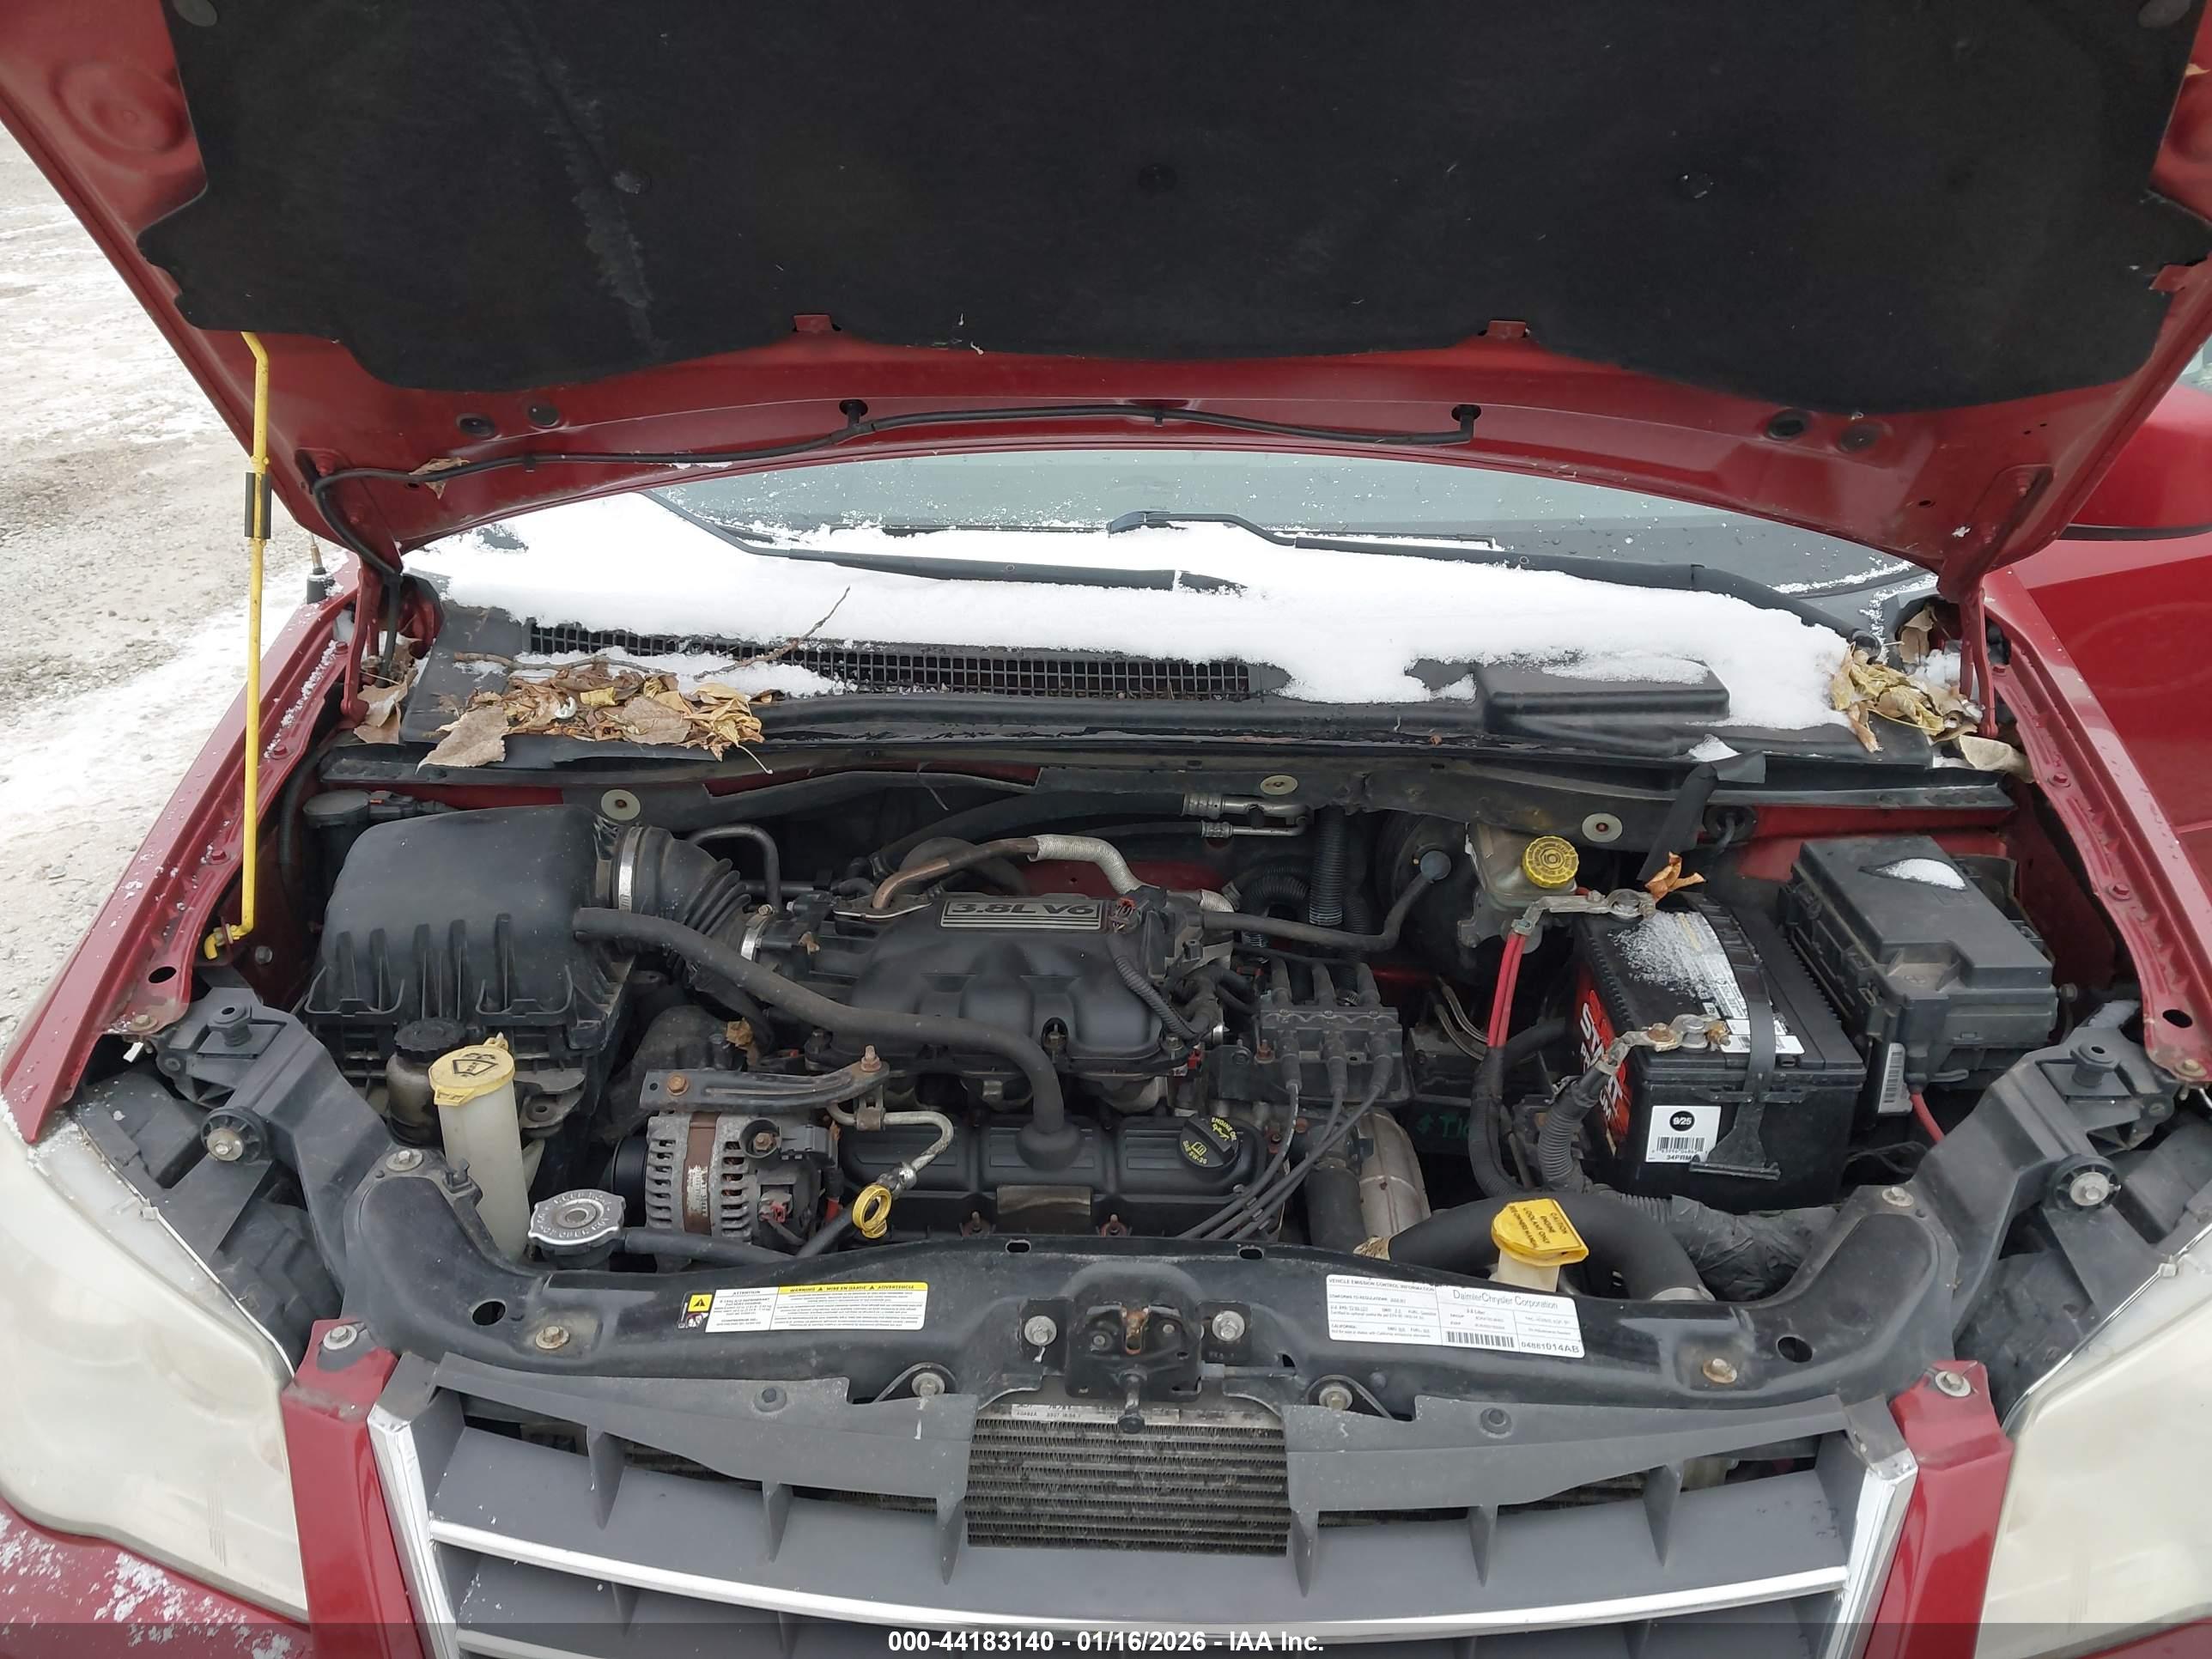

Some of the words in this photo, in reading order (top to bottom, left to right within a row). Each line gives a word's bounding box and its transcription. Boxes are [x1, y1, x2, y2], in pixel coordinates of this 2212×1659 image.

[951, 903, 1036, 914] 3.8L
[1043, 904, 1095, 915] V6
[1211, 1116, 1233, 1133] ENGINE
[1673, 1116, 1692, 1126] 9/25
[1522, 1206, 1542, 1231] COOLANT
[1537, 1229, 1551, 1244] ONLY
[1540, 1215, 1557, 1234] ENGINE
[1549, 1212, 1568, 1235] CAUTION
[1452, 1290, 1513, 1305] DaimlerChrysler
[1514, 1295, 1559, 1310] Corporation
